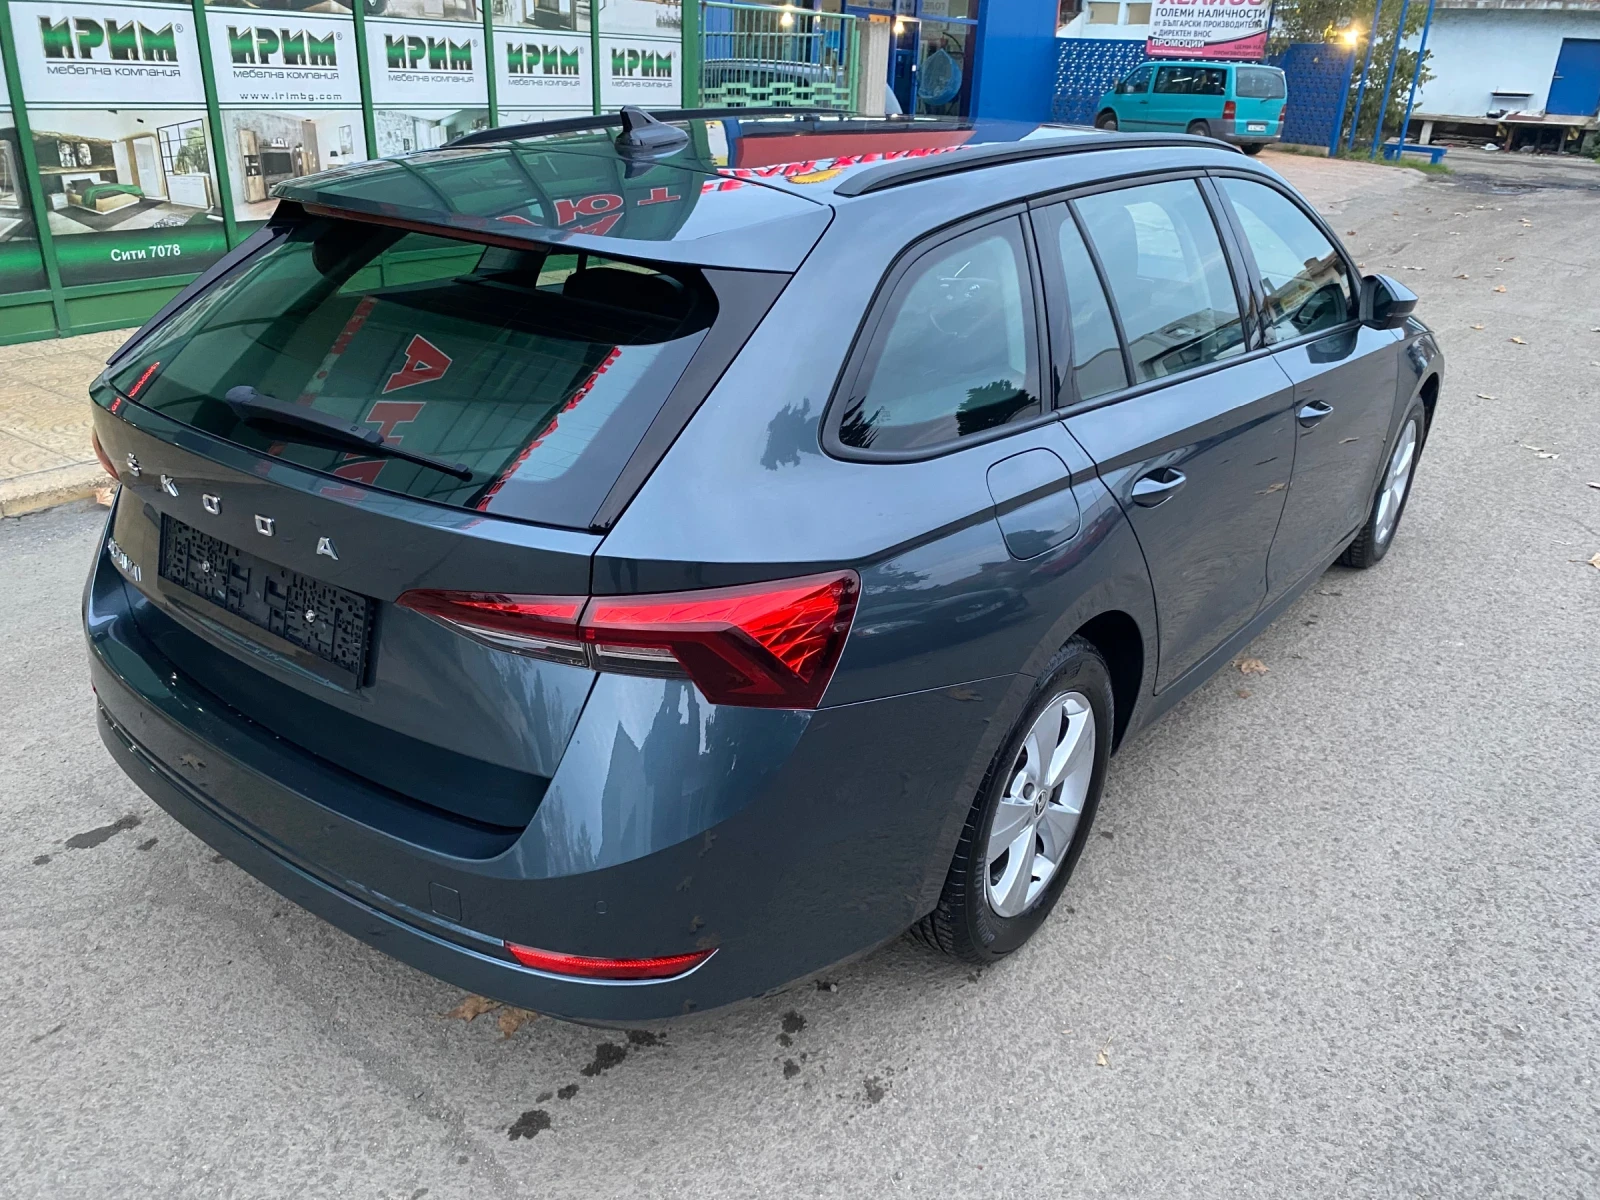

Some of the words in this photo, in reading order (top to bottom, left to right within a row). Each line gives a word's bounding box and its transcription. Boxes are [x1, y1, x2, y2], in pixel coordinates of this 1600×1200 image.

[1155, 8, 1194, 18] ГОЛЕМИ
[1197, 8, 1266, 19] НАЛИЧНОСТИ
[1162, 19, 1201, 28] БЪЛГАРСКИ
[37, 15, 178, 62] ИРИМ
[1158, 29, 1192, 37] ДИРЕКТЕН
[1194, 30, 1212, 38] ВНОС
[226, 25, 337, 67] ИРИМ
[1151, 38, 1205, 49] ПРОМОЦИИ
[384, 33, 473, 71] ИРИМ
[506, 41, 579, 75] ИРИМ
[611, 46, 672, 77] ИРИМ
[47, 64, 112, 75] мебелна
[114, 66, 181, 77] компания
[233, 69, 284, 79] мебелна
[286, 71, 339, 80] компания
[388, 73, 429, 82] мебелна
[431, 75, 474, 83] компания
[239, 92, 342, 101] www.irimbg.com
[110, 249, 146, 261] Сити
[149, 243, 181, 258] 7078
